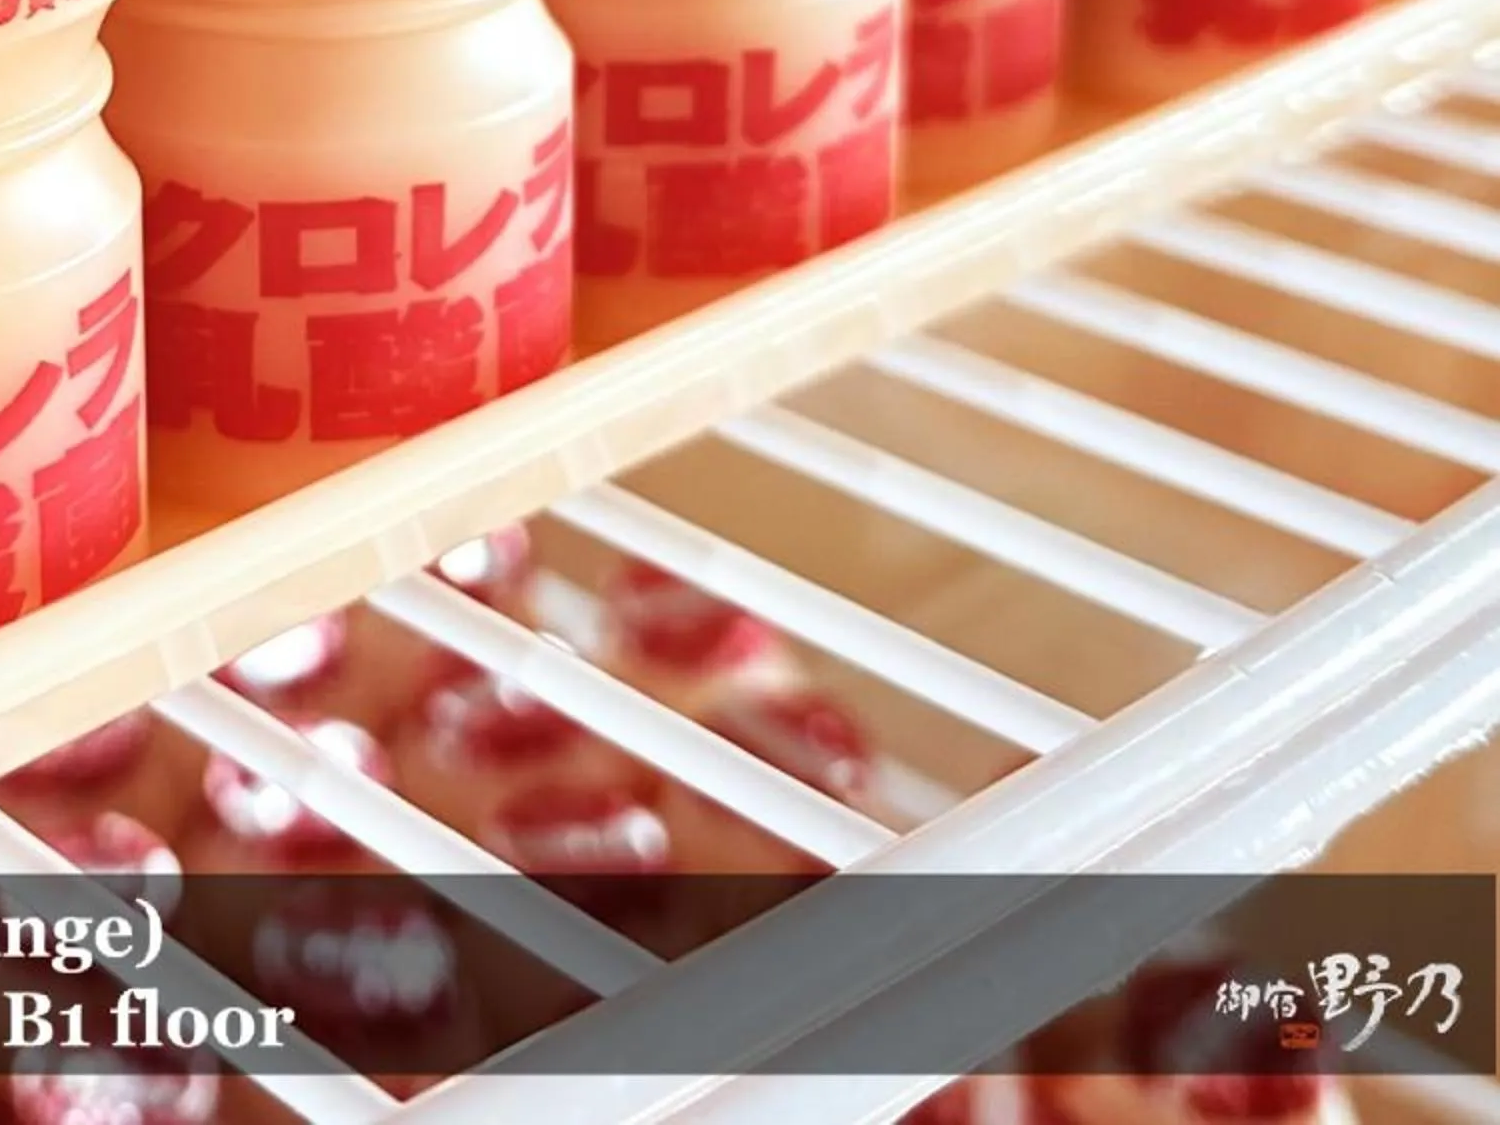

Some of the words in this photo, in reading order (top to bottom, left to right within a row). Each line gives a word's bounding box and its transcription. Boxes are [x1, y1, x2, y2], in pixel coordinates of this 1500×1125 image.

[575, 3, 894, 148] ロレラ
[143, 117, 569, 299] クロレラ
